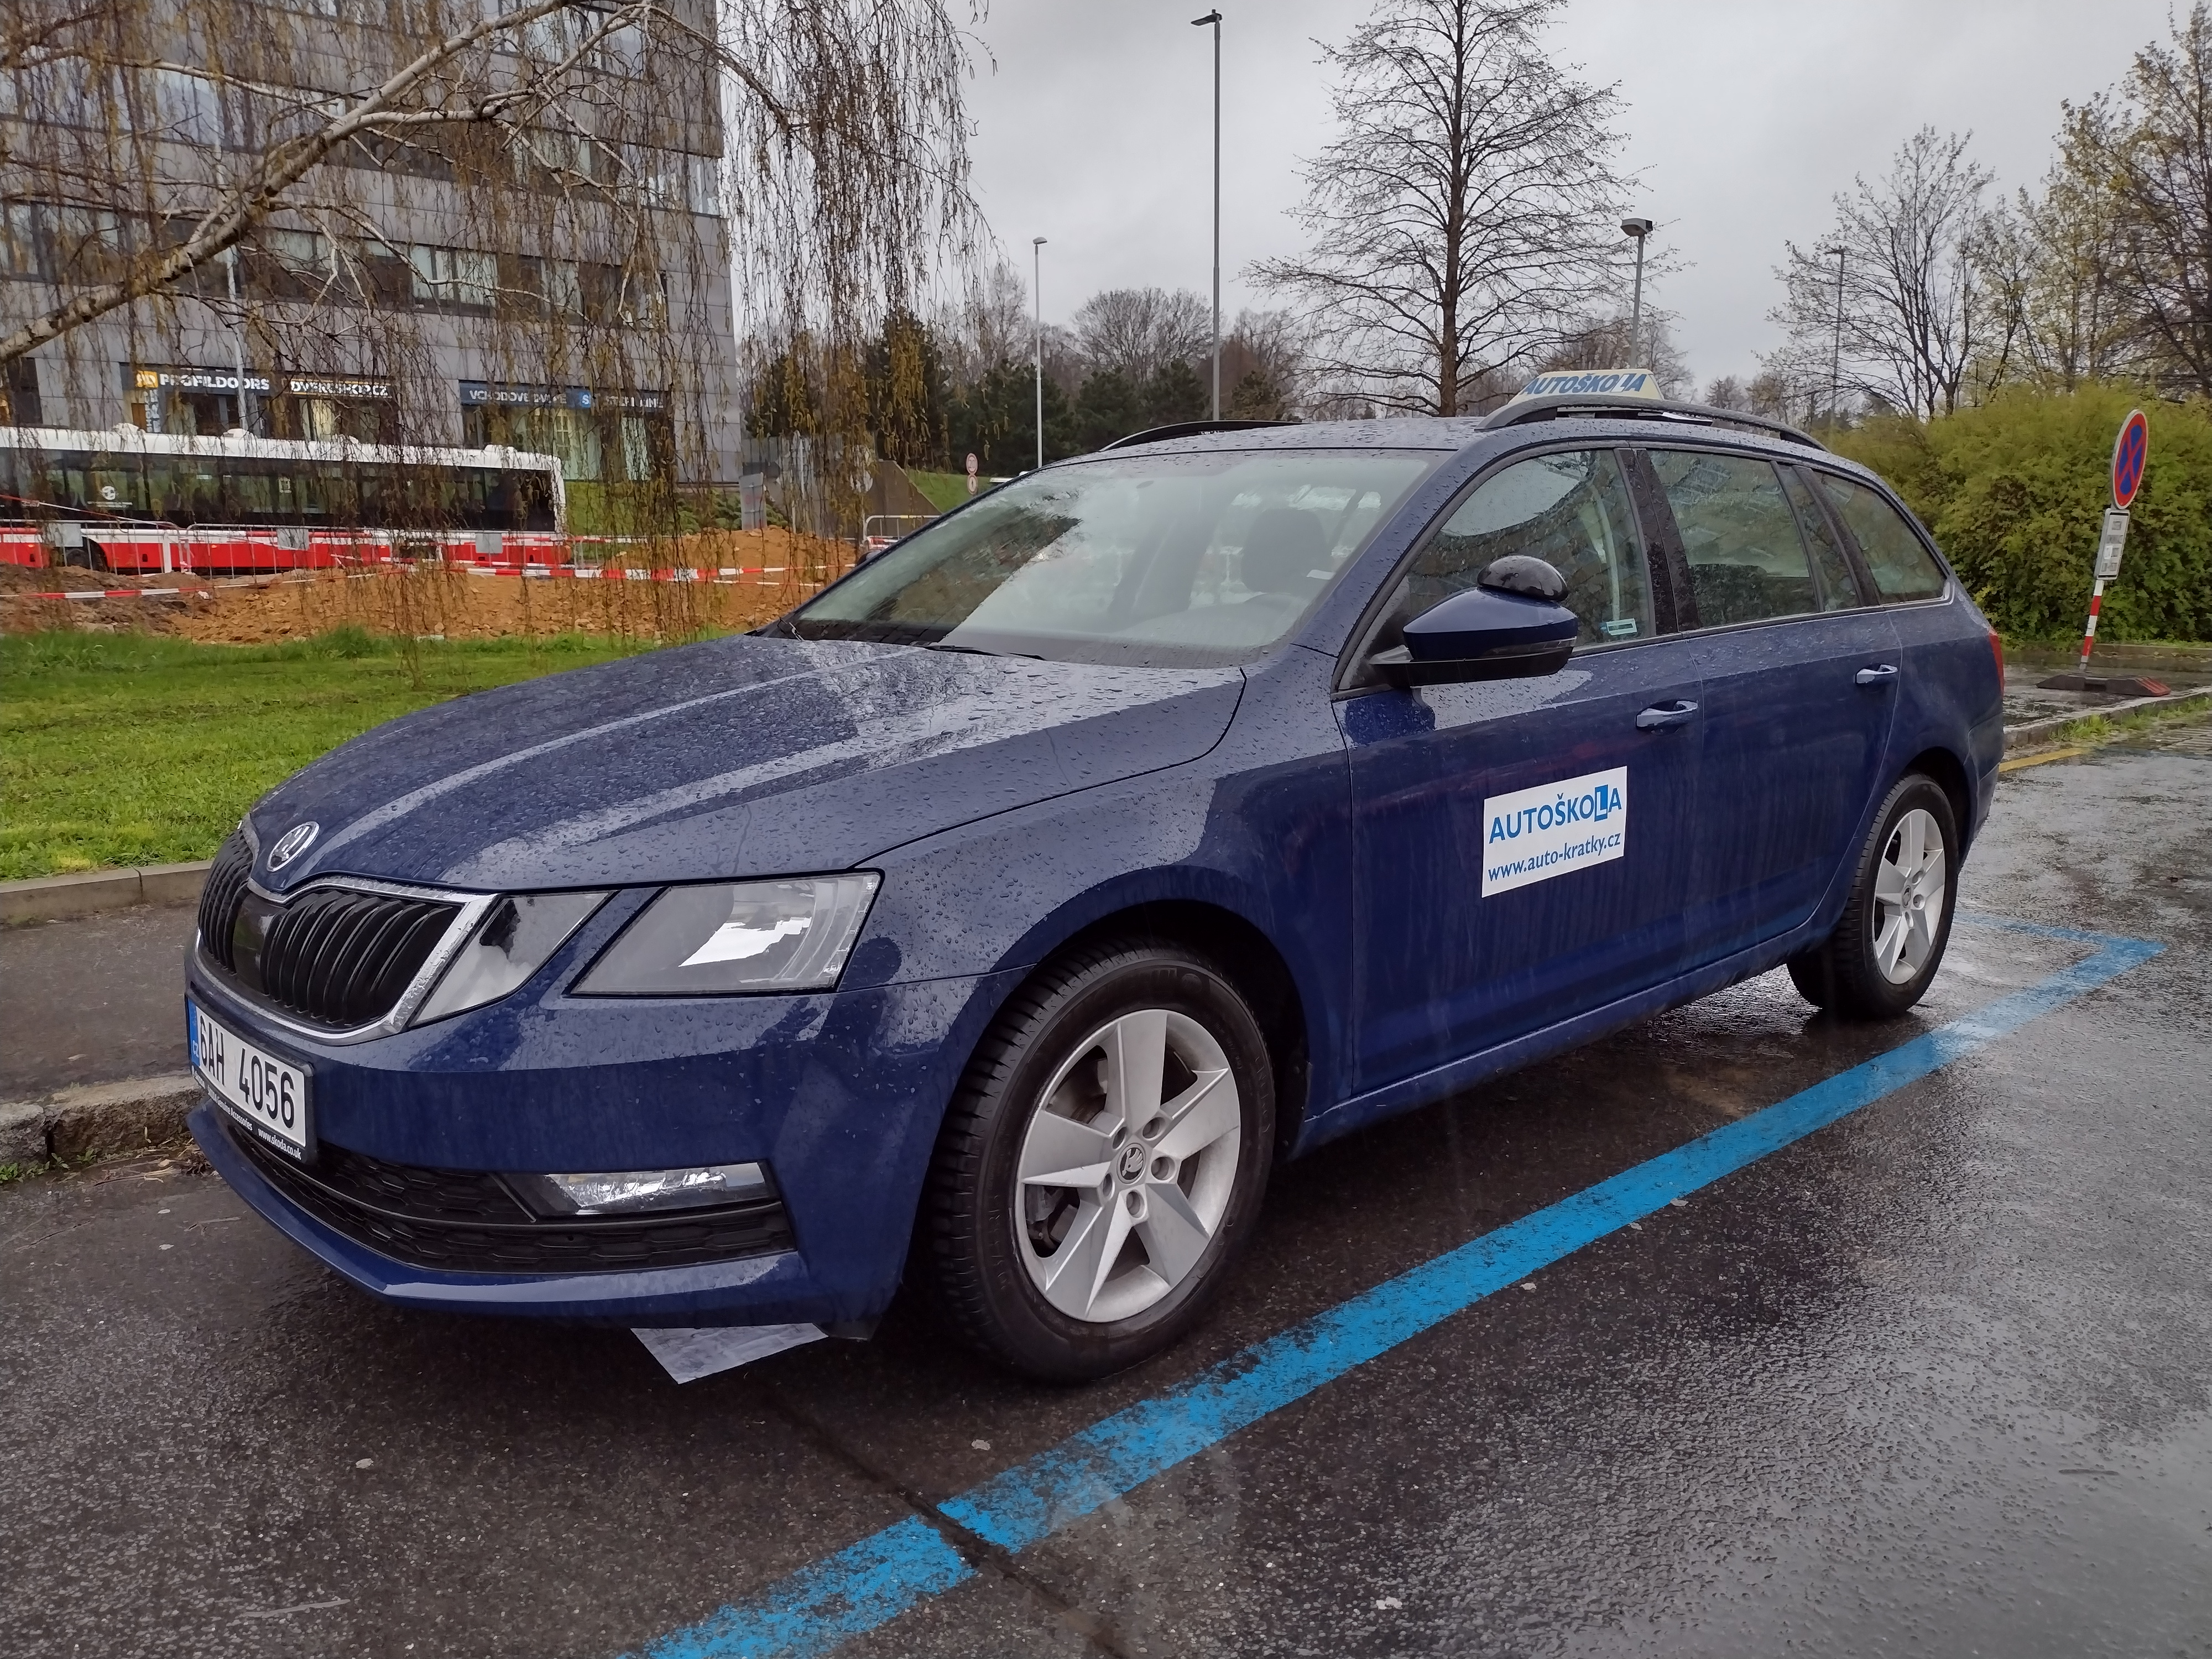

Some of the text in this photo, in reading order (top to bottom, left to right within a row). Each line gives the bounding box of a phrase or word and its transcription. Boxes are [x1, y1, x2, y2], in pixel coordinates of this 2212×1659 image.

[1522, 373, 1647, 395] AUTOŠKOLA
[1489, 784, 1623, 844] AUTOŠKOLA
[1488, 832, 1621, 881] www.auto-kratky.cz
[192, 1040, 199, 1058] CZ
[200, 1015, 295, 1129] 6AH 4056
[217, 1096, 231, 1115] Genuine
[231, 1107, 253, 1131] Accessories
[258, 1128, 301, 1160] www.skoda.co.uk
